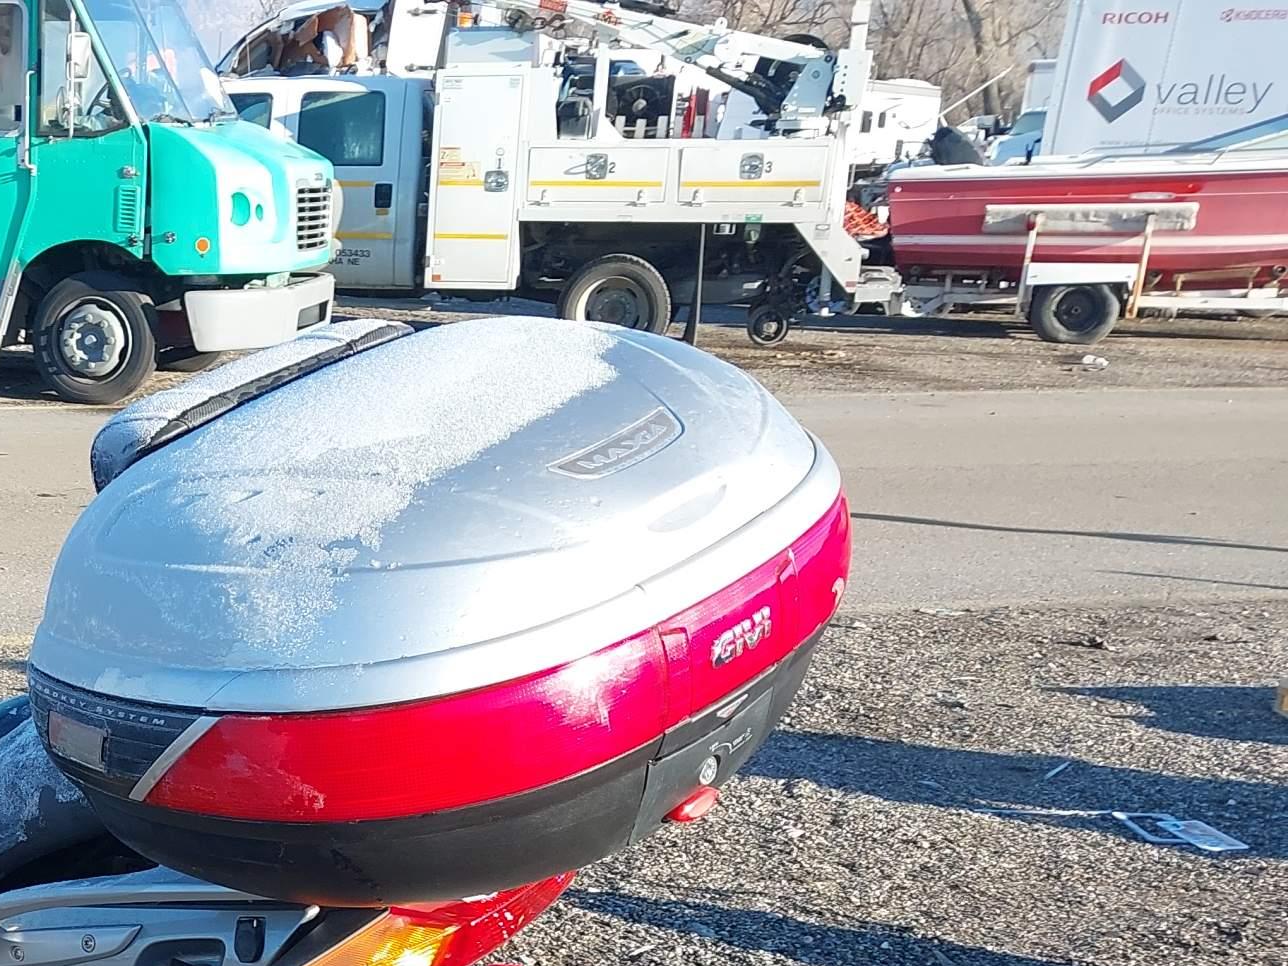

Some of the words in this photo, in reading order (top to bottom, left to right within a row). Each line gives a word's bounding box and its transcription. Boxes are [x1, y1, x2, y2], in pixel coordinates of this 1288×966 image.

[1101, 11, 1170, 25] RICOH
[1156, 73, 1274, 114] valley
[608, 162, 616, 174] 2
[764, 161, 773, 174] 3
[347, 257, 361, 266] NE
[711, 605, 772, 668] GIVI
[95, 705, 166, 726] SYSTEM
